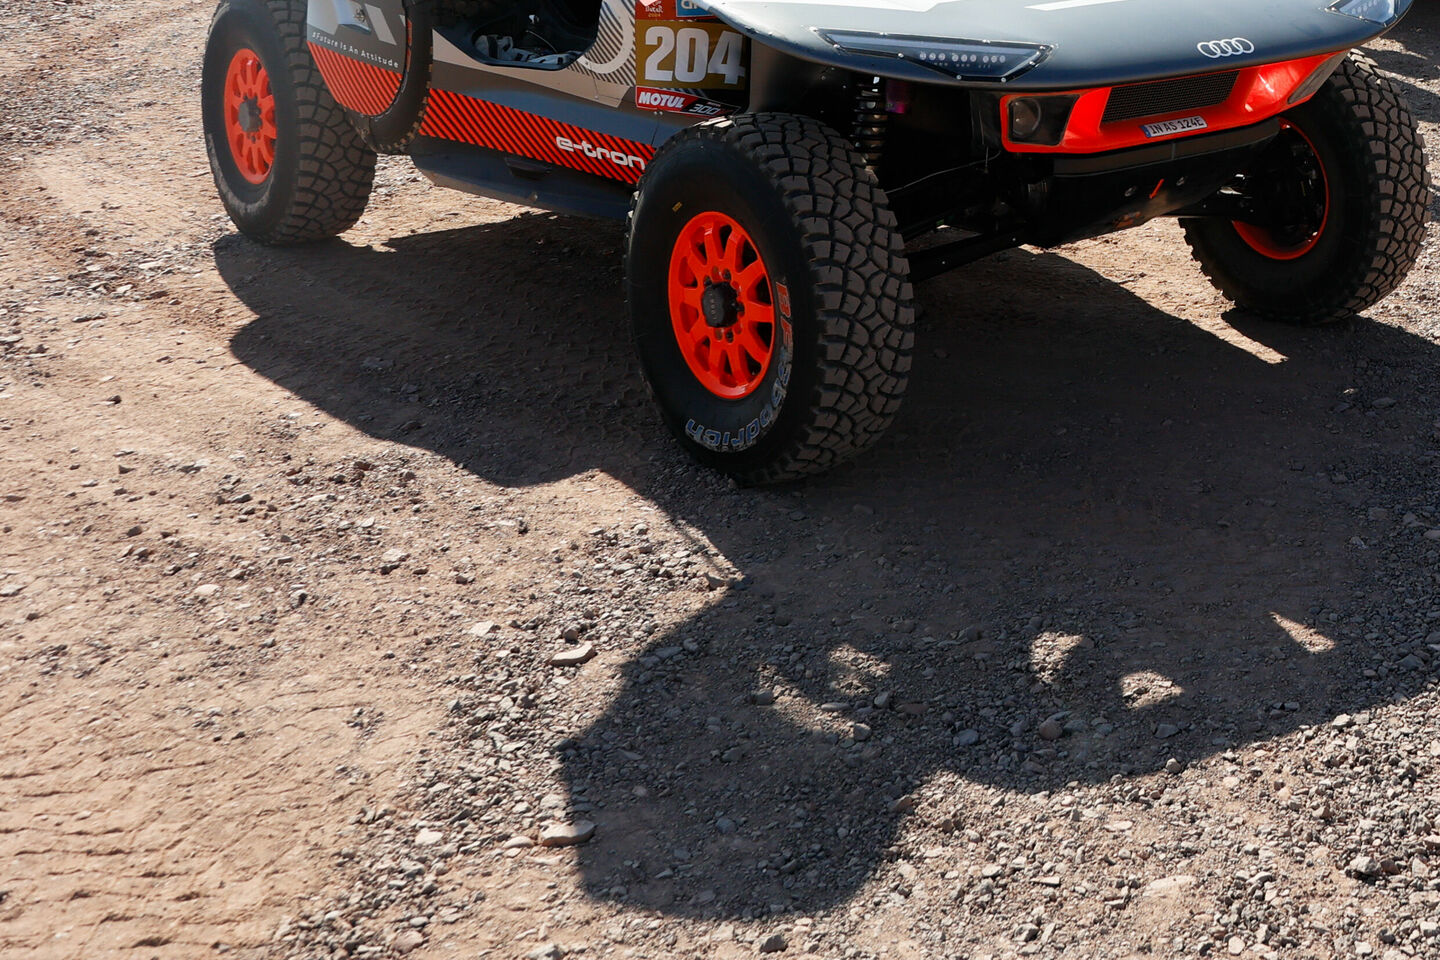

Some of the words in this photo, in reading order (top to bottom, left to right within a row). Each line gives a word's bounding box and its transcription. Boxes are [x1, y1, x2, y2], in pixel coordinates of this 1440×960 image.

[349, 45, 359, 55] An
[361, 49, 399, 68] Attitude
[645, 25, 746, 86] 204
[638, 91, 686, 109] MOTUL
[1163, 121, 1178, 132] AS
[555, 136, 646, 171] e-tron
